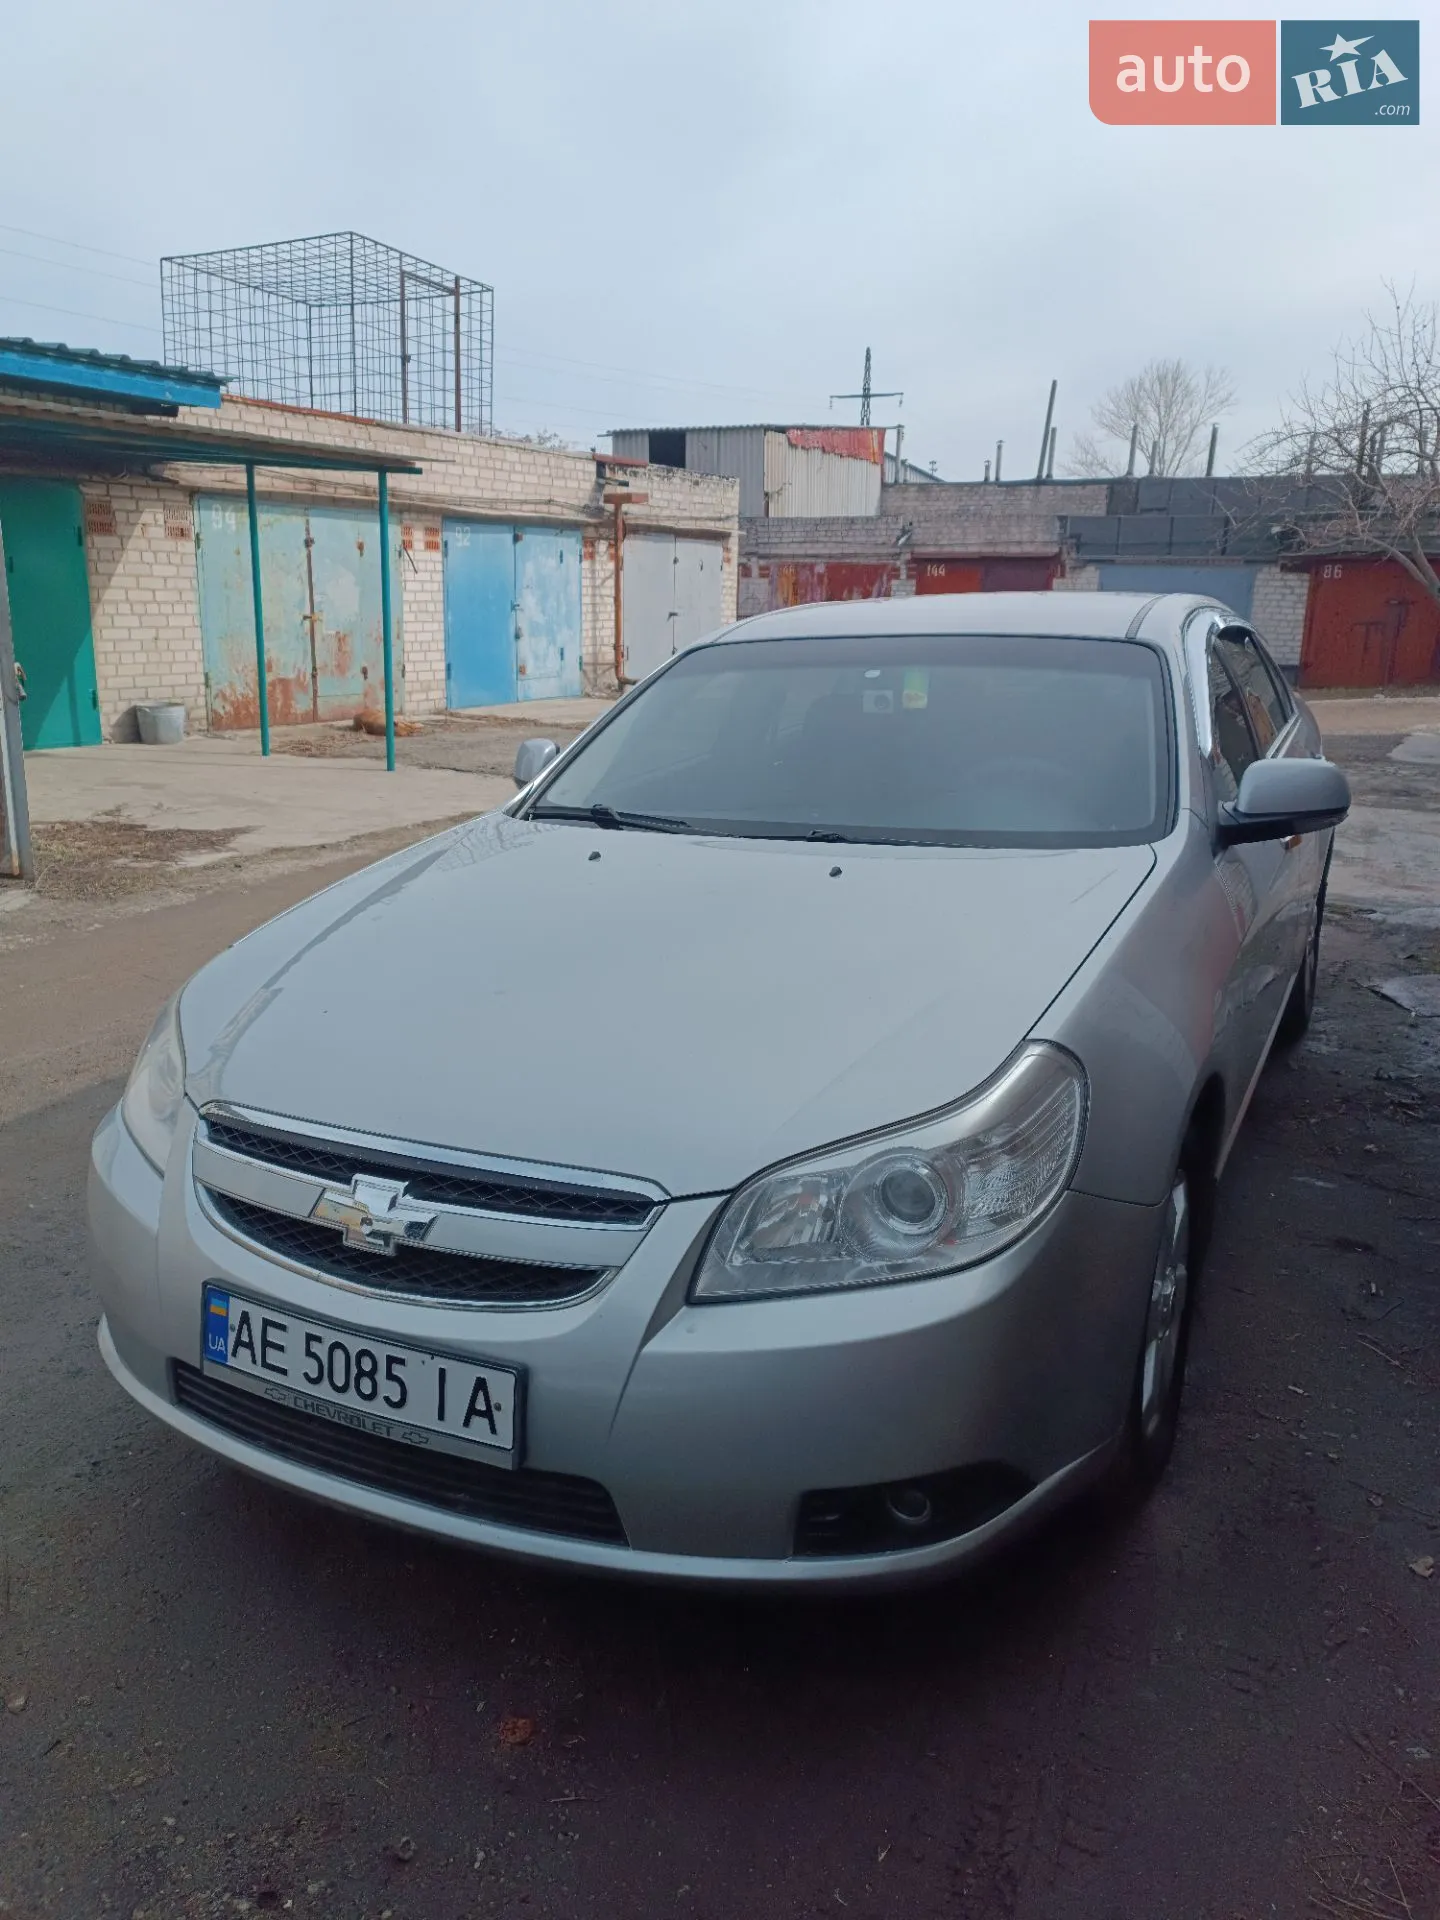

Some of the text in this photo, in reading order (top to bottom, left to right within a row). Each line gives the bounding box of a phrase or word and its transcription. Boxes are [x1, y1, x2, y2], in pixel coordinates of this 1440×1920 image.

[1323, 564, 1343, 578] 86
[208, 1333, 226, 1354] UA
[231, 1310, 498, 1435] AE 5085 IA
[293, 1395, 394, 1437] CHEVROLET
